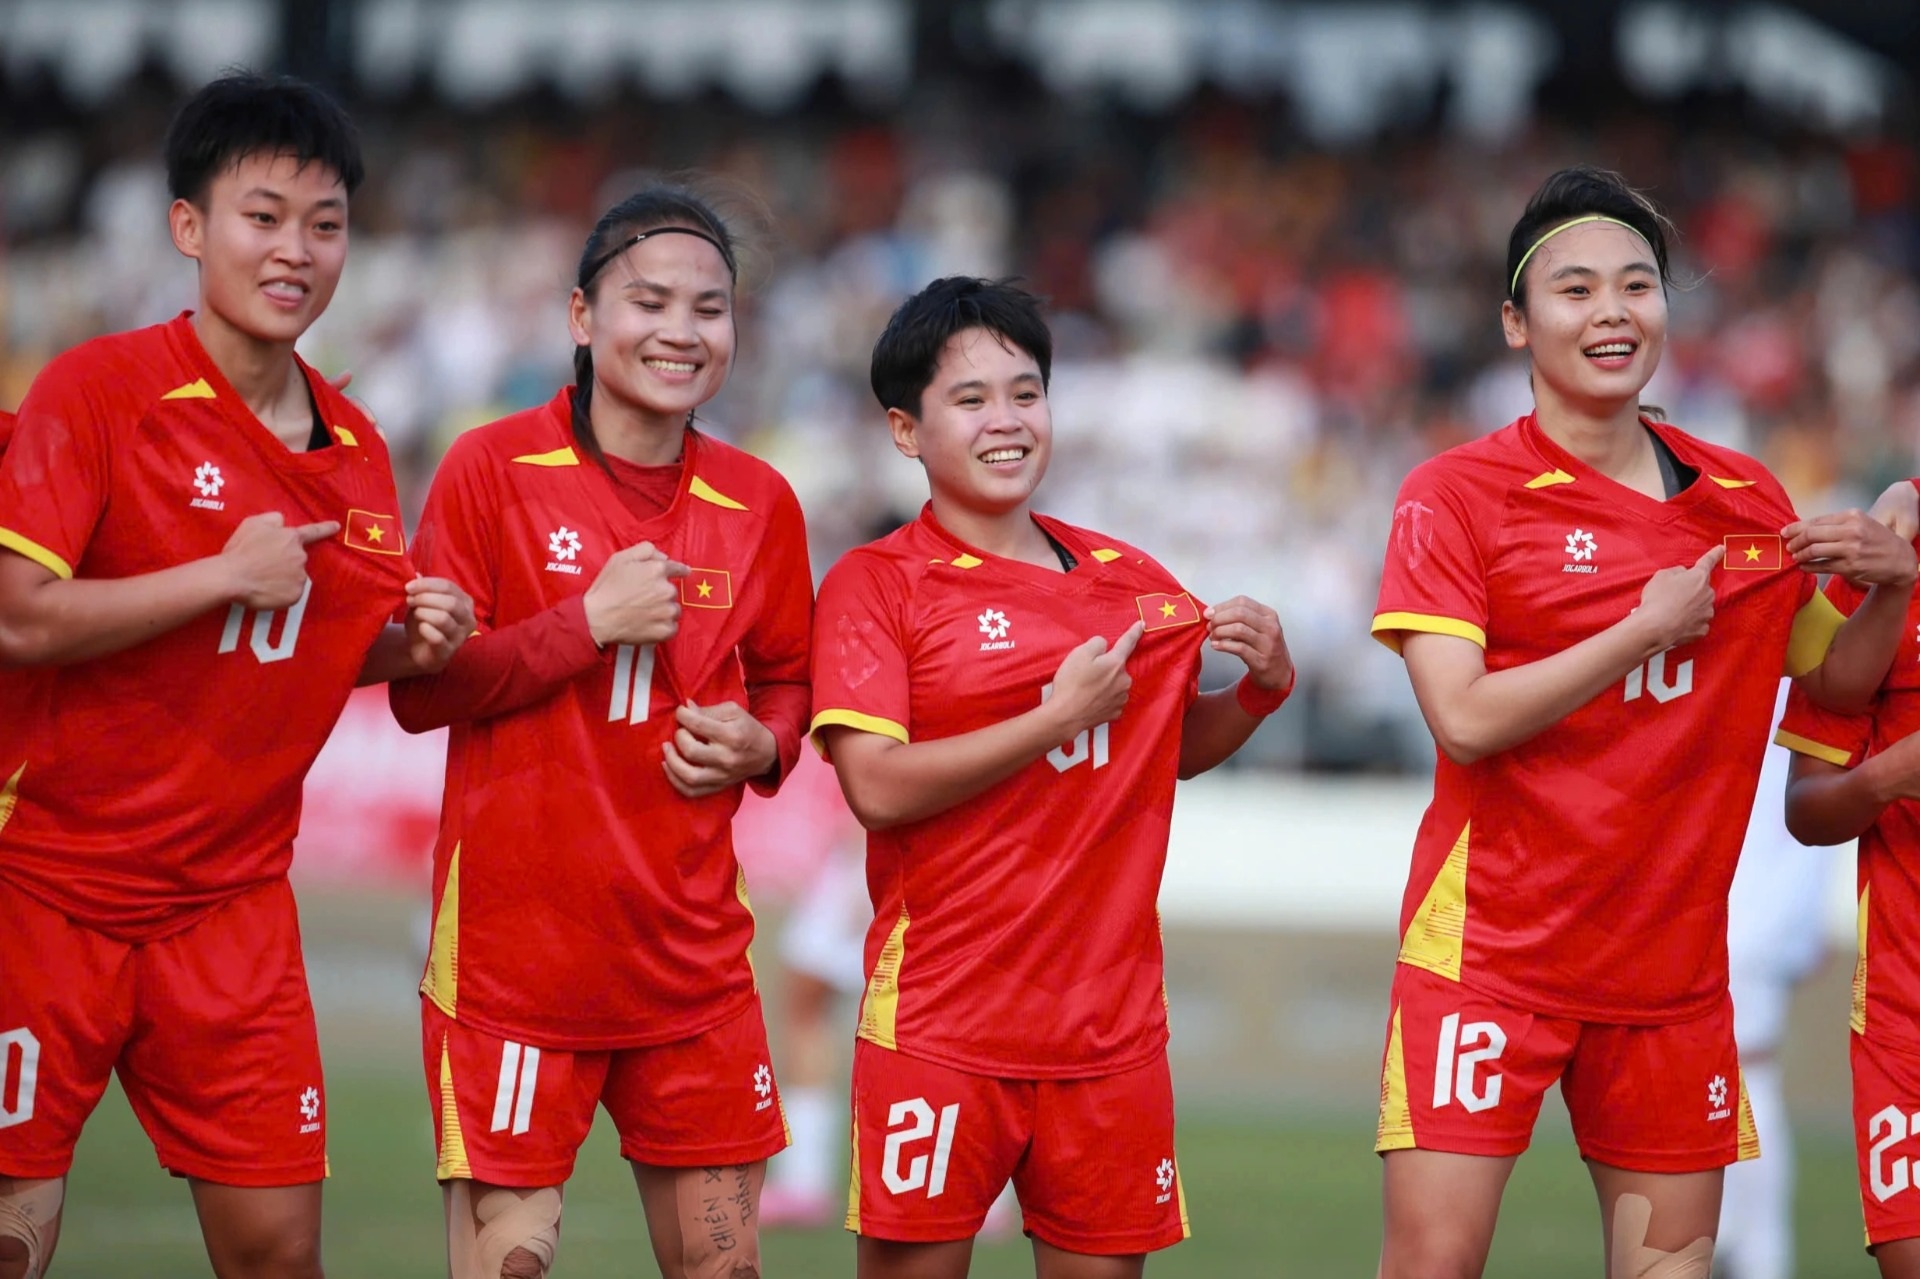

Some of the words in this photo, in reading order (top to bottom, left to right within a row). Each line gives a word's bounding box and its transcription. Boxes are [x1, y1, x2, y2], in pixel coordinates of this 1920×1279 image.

[490, 1040, 540, 1136] 11
[1432, 1012, 1507, 1114] 12
[881, 1097, 960, 1199] 21
